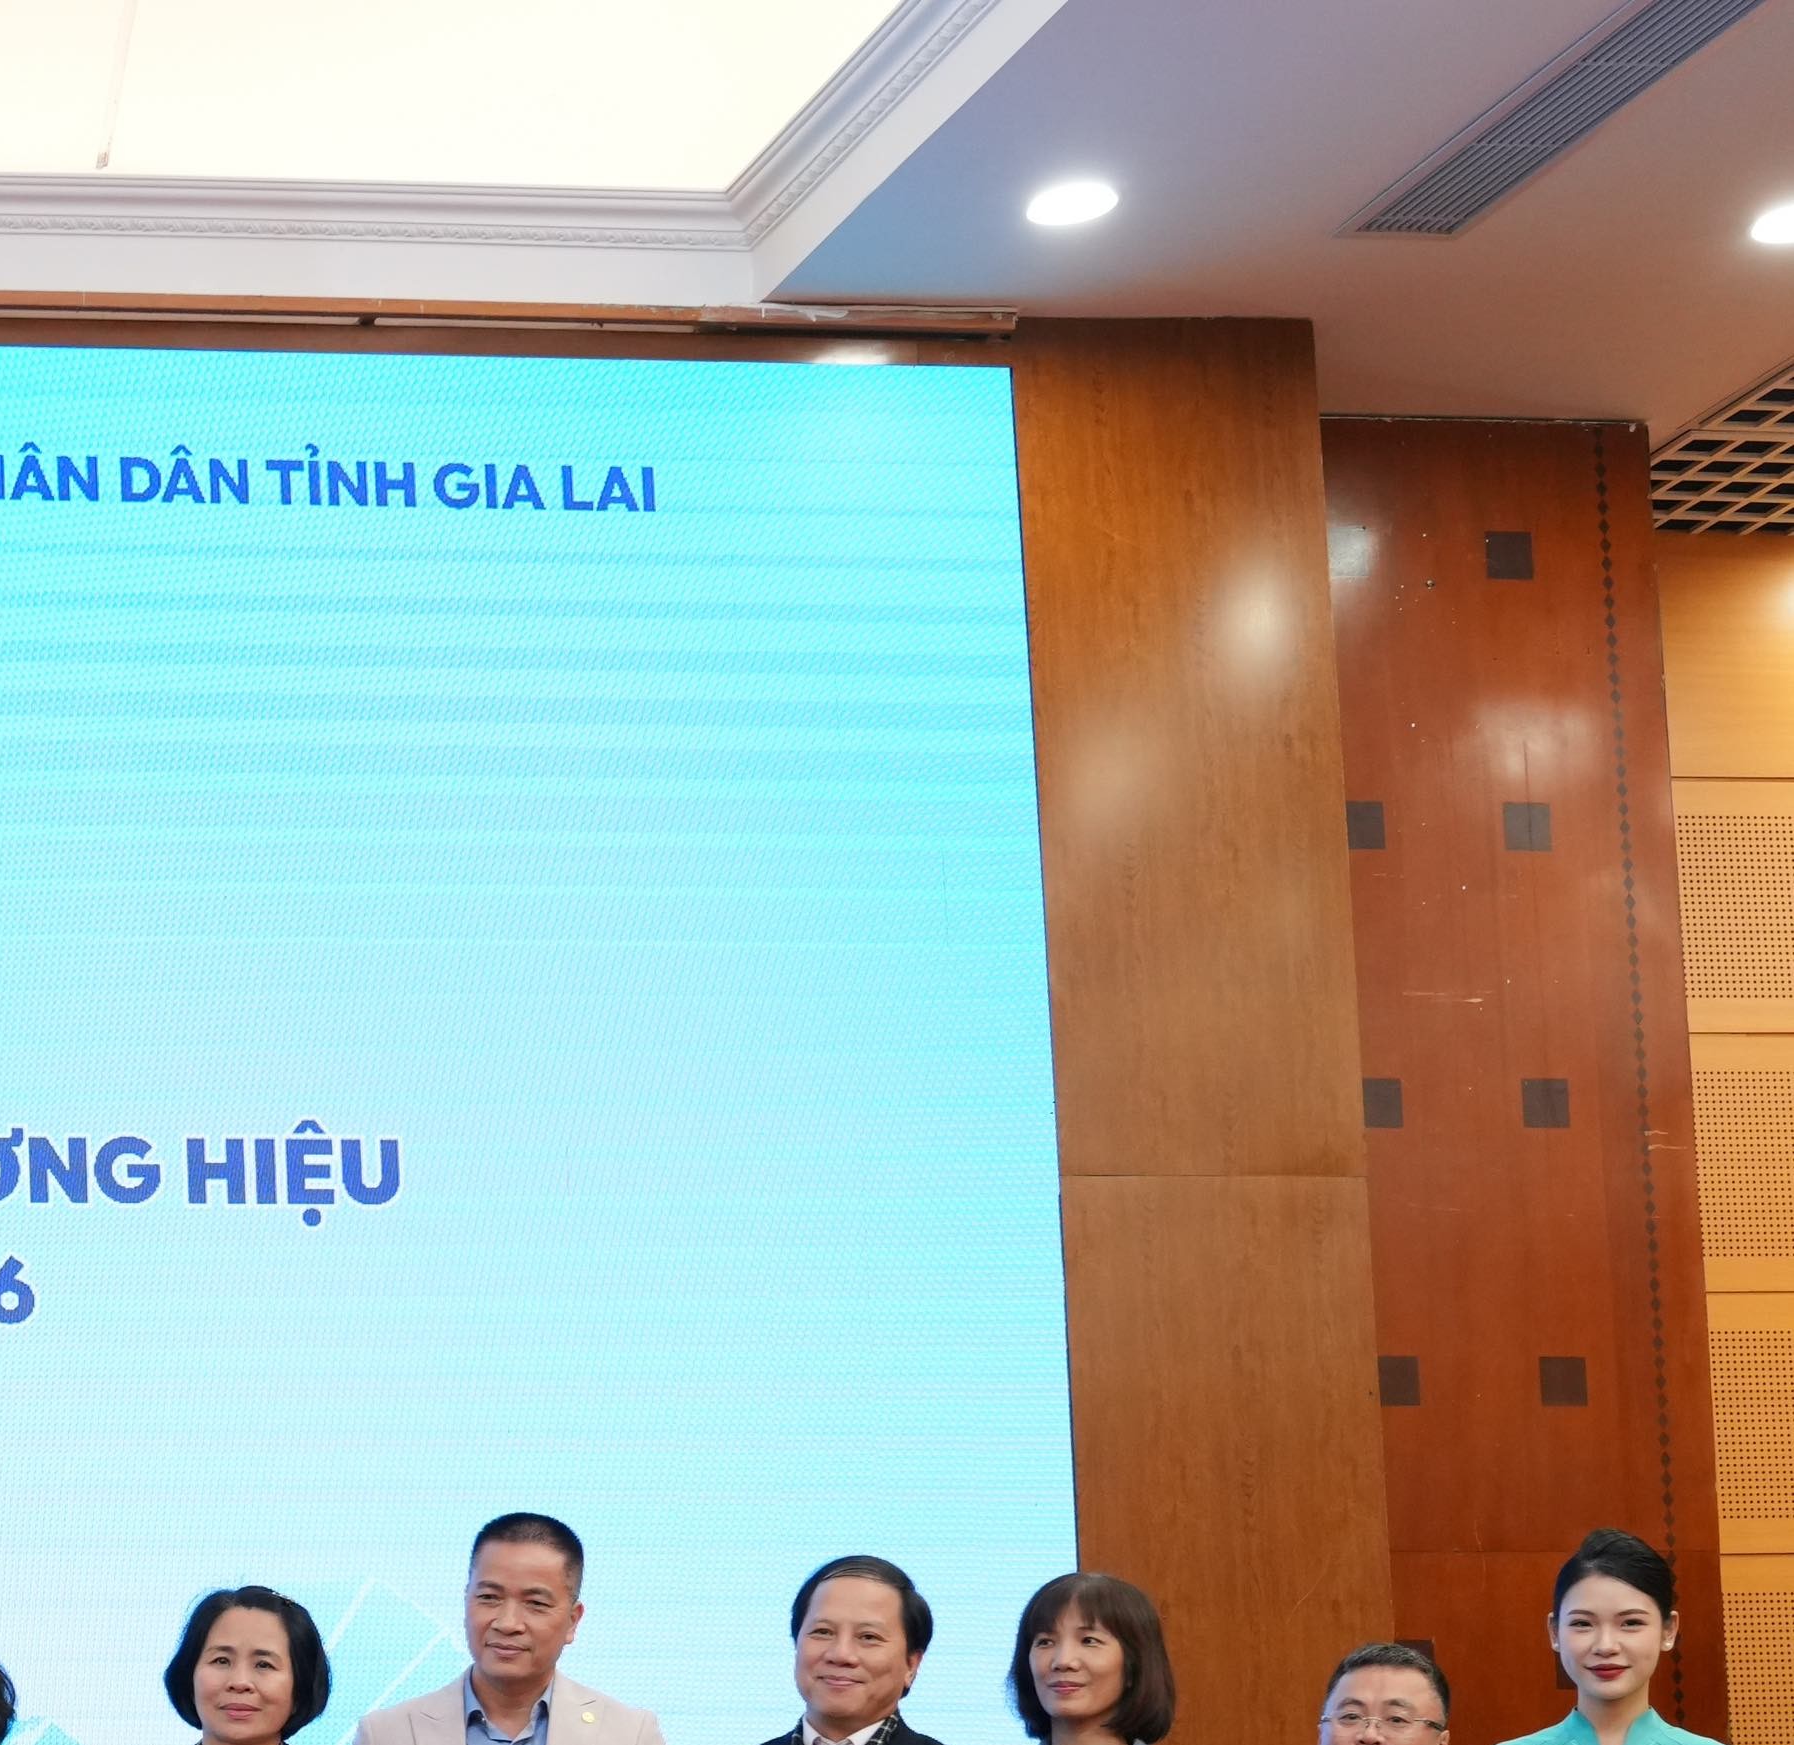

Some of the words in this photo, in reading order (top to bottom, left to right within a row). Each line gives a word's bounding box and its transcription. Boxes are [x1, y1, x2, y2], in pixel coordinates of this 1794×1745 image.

[119, 444, 250, 505] DÂN
[265, 442, 417, 508] TỈNH
[433, 462, 546, 511] GIA
[561, 465, 657, 513] LAI
[186, 1119, 401, 1227] HIỆU
